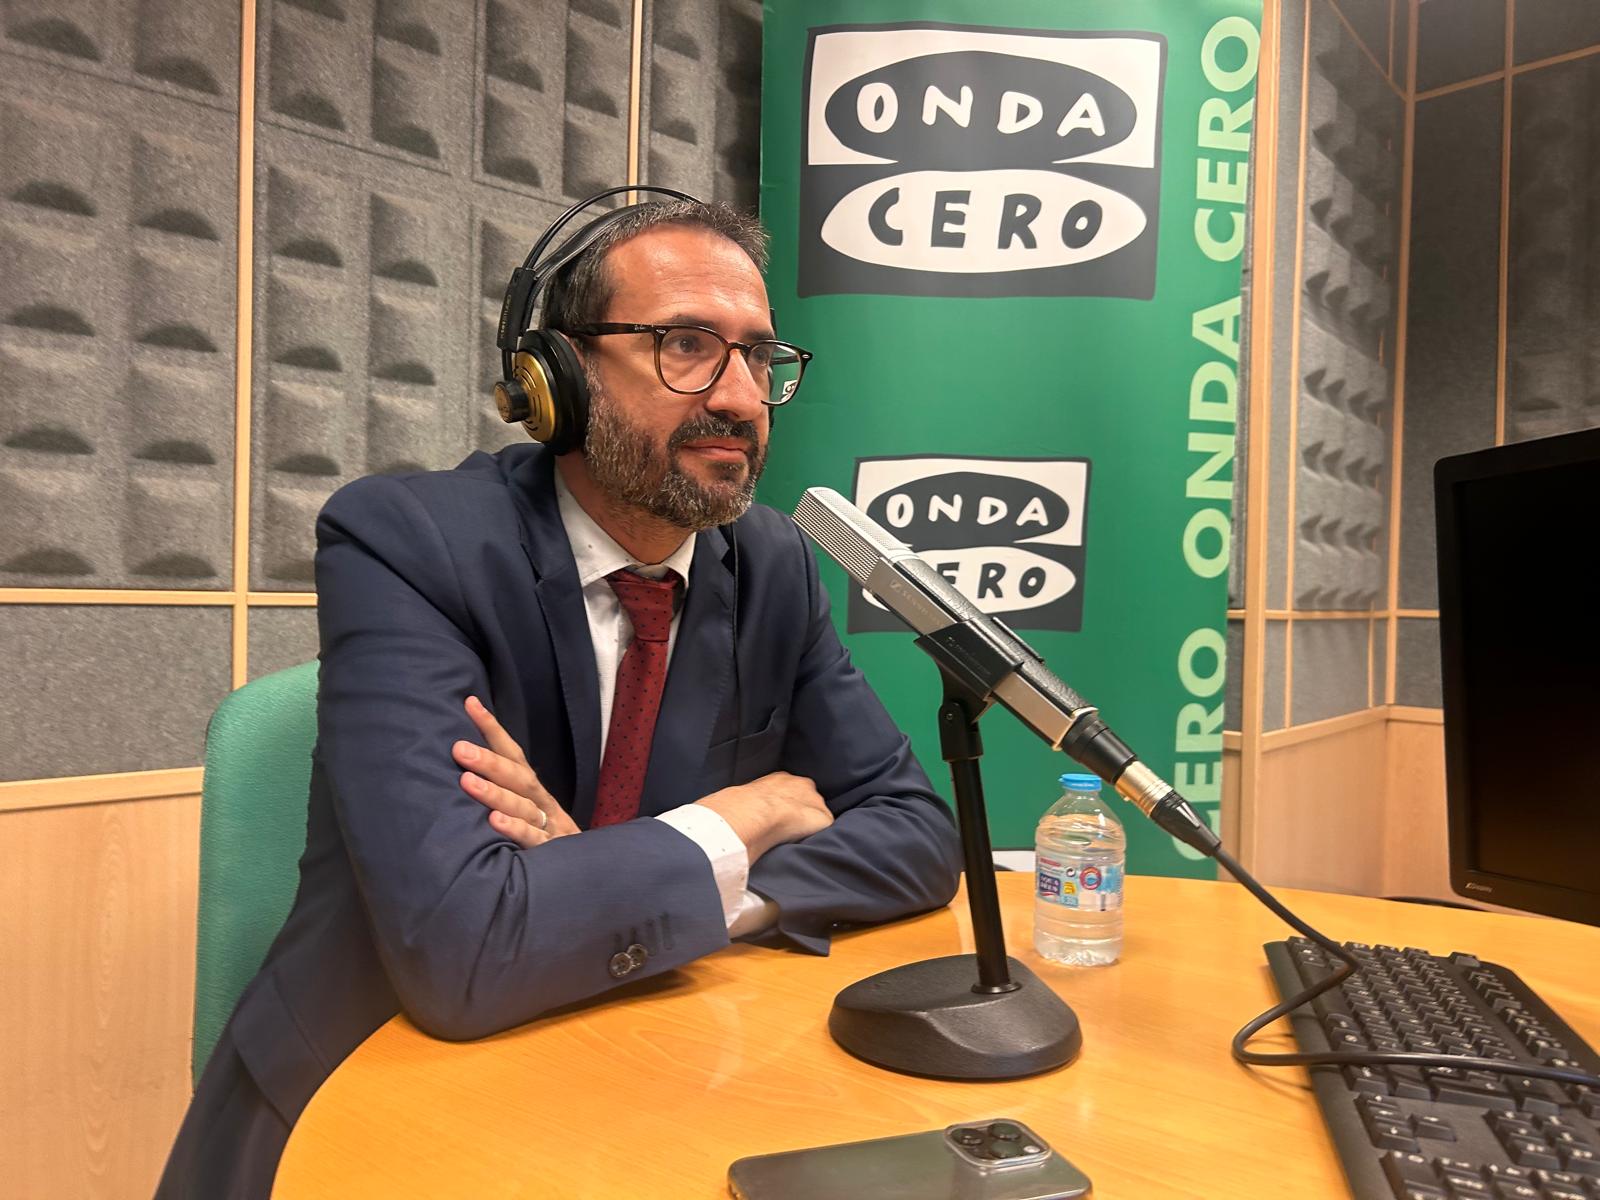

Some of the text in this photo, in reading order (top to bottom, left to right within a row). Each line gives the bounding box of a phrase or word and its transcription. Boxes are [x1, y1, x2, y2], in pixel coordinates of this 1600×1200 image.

[857, 82, 1106, 137] ONDA
[1194, 16, 1261, 262] CERO
[868, 187, 1104, 250] CERO
[1182, 295, 1243, 579] ONDA
[886, 493, 1049, 527] ONDA
